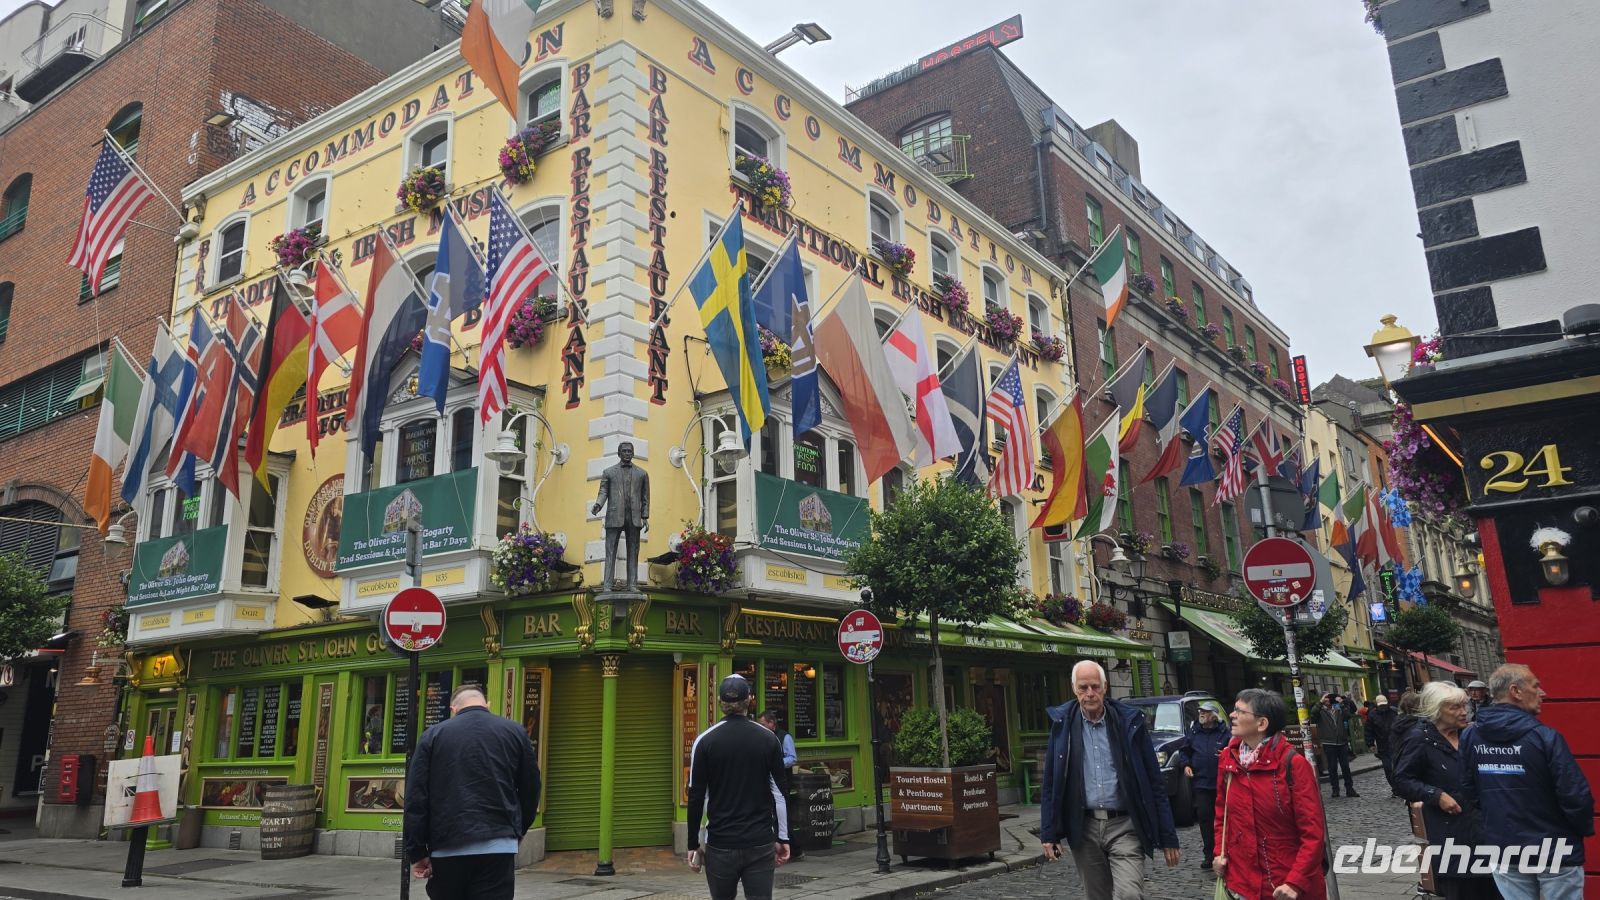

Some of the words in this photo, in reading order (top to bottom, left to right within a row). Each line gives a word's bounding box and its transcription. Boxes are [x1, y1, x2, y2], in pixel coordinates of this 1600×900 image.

[571, 63, 593, 143] BAR
[648, 64, 670, 147] BAR
[688, 36, 1033, 287] ACCOMMODATION
[561, 146, 593, 410] RESTAURANT
[648, 147, 670, 406] RESTAURANT
[1296, 357, 1310, 404] HOSTEL
[1480, 444, 1575, 496] 24
[422, 525, 454, 539] Gogarty
[429, 541, 442, 550] Bar
[442, 537, 449, 546] 7
[449, 535, 468, 547] Days
[763, 534, 779, 545] Trad
[779, 538, 807, 549] Sessions
[807, 542, 813, 551] &
[775, 524, 788, 536] The
[789, 527, 810, 540] Oliver
[820, 534, 835, 544] John
[835, 536, 861, 549] Gogarty
[353, 540, 367, 551] The
[367, 536, 390, 548] Oliver
[304, 540, 327, 572] DUBLIN
[339, 555, 354, 565] Trad
[355, 551, 384, 562] Sessions
[384, 549, 391, 558] &
[139, 582, 148, 591] The
[187, 573, 209, 586] Gogarty
[139, 592, 159, 600] Sessions
[176, 586, 191, 597] Night
[190, 585, 200, 593] Bar
[204, 582, 216, 592] Days
[523, 613, 563, 639] BAR
[665, 609, 703, 635] BAR
[744, 616, 830, 641] RESTAURANT
[211, 649, 236, 671] THE
[242, 645, 291, 668] OLIVER
[298, 640, 318, 660] ST.
[320, 636, 358, 659] JOHN
[153, 657, 168, 678] 57
[1474, 745, 1514, 755] Vikenco
[896, 775, 922, 785] Tourist
[923, 775, 947, 785] Hostel
[899, 788, 905, 797] &
[906, 789, 943, 799] Penthouse
[963, 787, 986, 798] Penthouse
[900, 802, 943, 813] Apartments
[962, 801, 989, 812] Apartments
